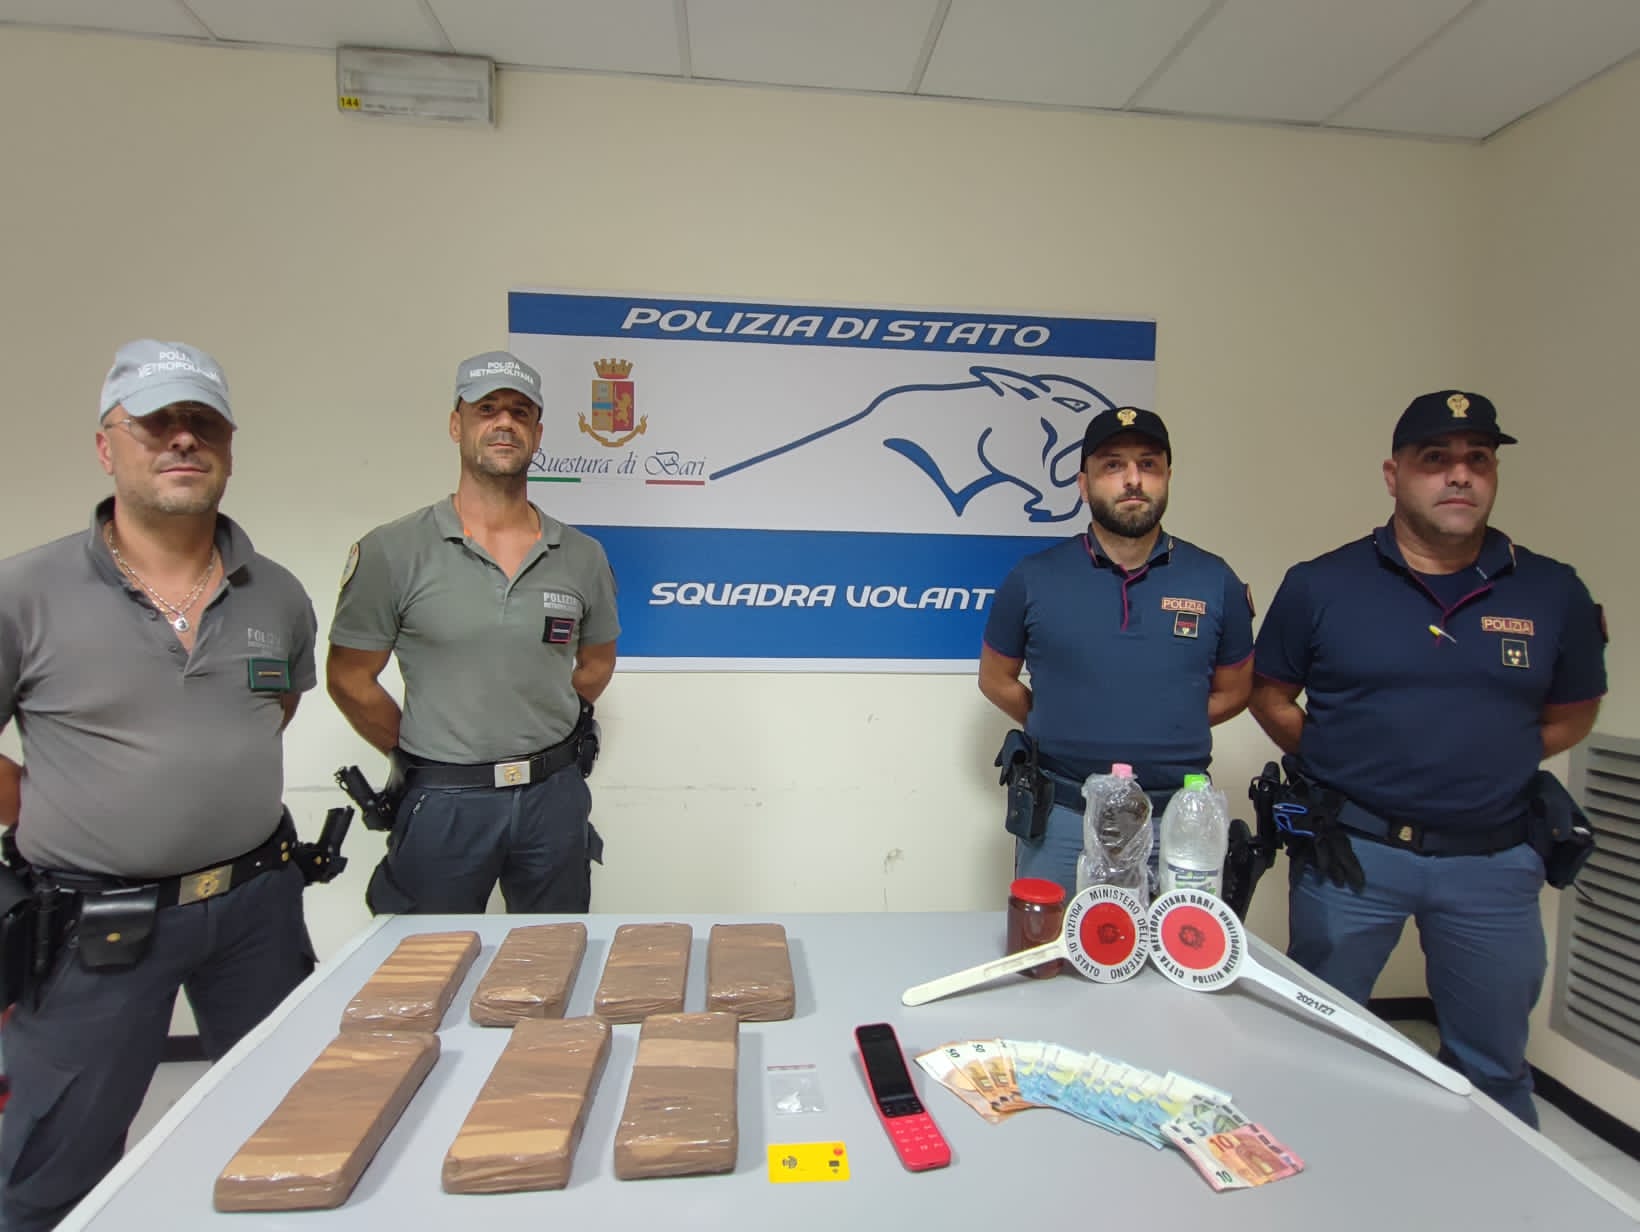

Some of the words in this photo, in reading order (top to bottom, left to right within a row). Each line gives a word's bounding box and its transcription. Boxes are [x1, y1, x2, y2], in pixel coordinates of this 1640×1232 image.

[340, 96, 360, 108] 144
[620, 307, 824, 338] POLIZIA
[826, 316, 881, 341] DI
[882, 319, 1051, 348] STATO
[528, 448, 612, 474] Questura
[616, 451, 638, 475] di
[644, 450, 706, 476] Bari
[649, 582, 837, 607] SQUADRA
[846, 585, 996, 611] VOLANT
[1163, 599, 1204, 612] POLIZIA
[1484, 619, 1531, 633] POLIZIA
[1089, 888, 1140, 915] MINISTERO
[1067, 903, 1083, 938] POLIZIA
[1150, 894, 1187, 952] METROPOLITANA
[1190, 894, 1215, 910] BARI
[1069, 942, 1078, 952] DI
[1110, 918, 1148, 979] DELL'INTERNO
[1075, 954, 1100, 977] STATO
[1192, 971, 1224, 984] POLIZIA
[1296, 991, 1336, 1016] 2021/27
[1209, 1134, 1235, 1153] 10
[1216, 1170, 1233, 1184] 10
